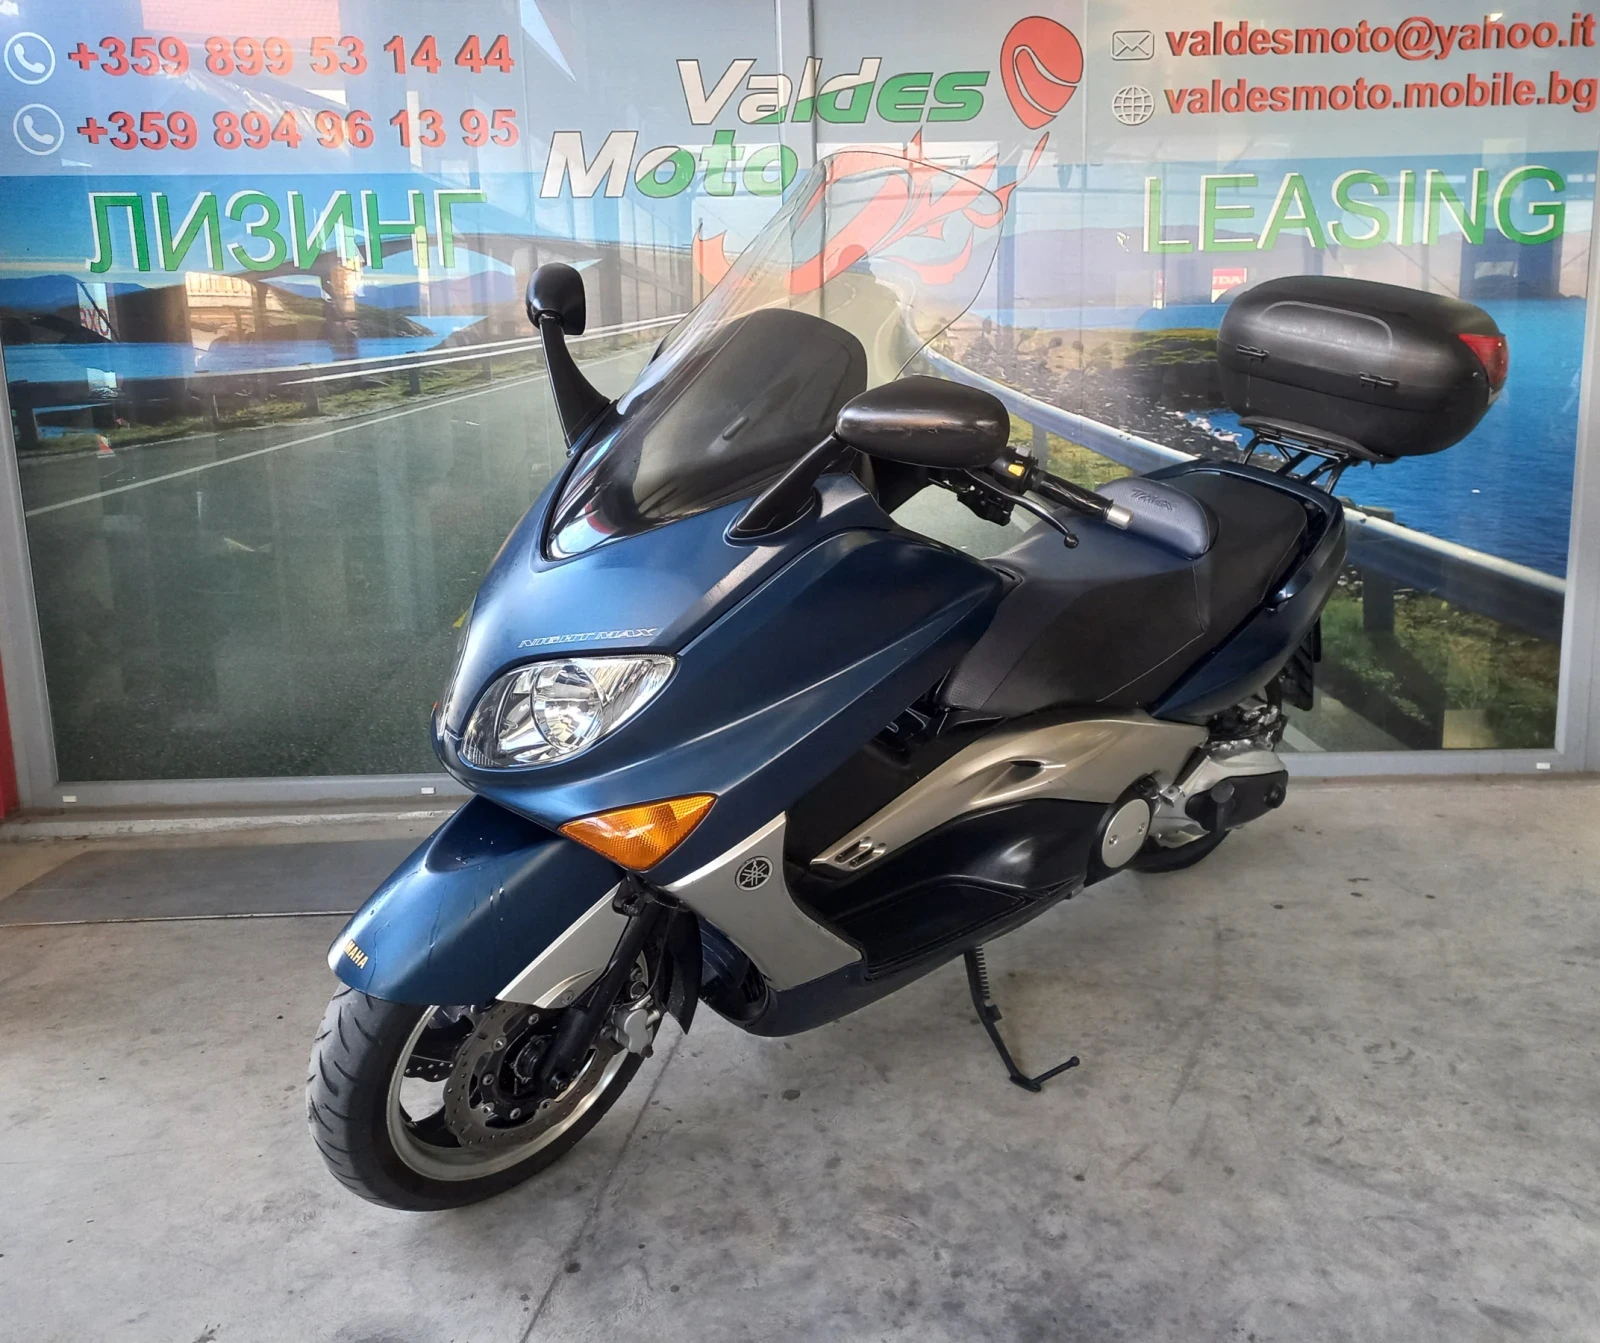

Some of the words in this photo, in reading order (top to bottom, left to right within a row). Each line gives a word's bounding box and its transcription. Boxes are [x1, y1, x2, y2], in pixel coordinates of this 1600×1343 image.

[67, 35, 190, 76] +359
[205, 36, 293, 75] 899
[309, 37, 367, 75] 53
[384, 35, 441, 74] 14
[455, 34, 514, 73] 44
[1165, 13, 1596, 60] valdesmoto@yahoo.it
[676, 57, 990, 125] Valdes
[1164, 71, 1598, 113] valdesmoto.mobile.bg
[77, 110, 198, 150] +359
[213, 111, 301, 149] 894
[315, 111, 374, 148] 96
[390, 109, 447, 148] 13
[461, 109, 519, 147] 95
[539, 130, 798, 199] Moto
[86, 189, 488, 273] ЛИЗИНГ
[1144, 165, 1566, 254] LEASING
[518, 632, 595, 648] NIGHT
[595, 628, 657, 640] MAX
[340, 937, 369, 970] MAHA
